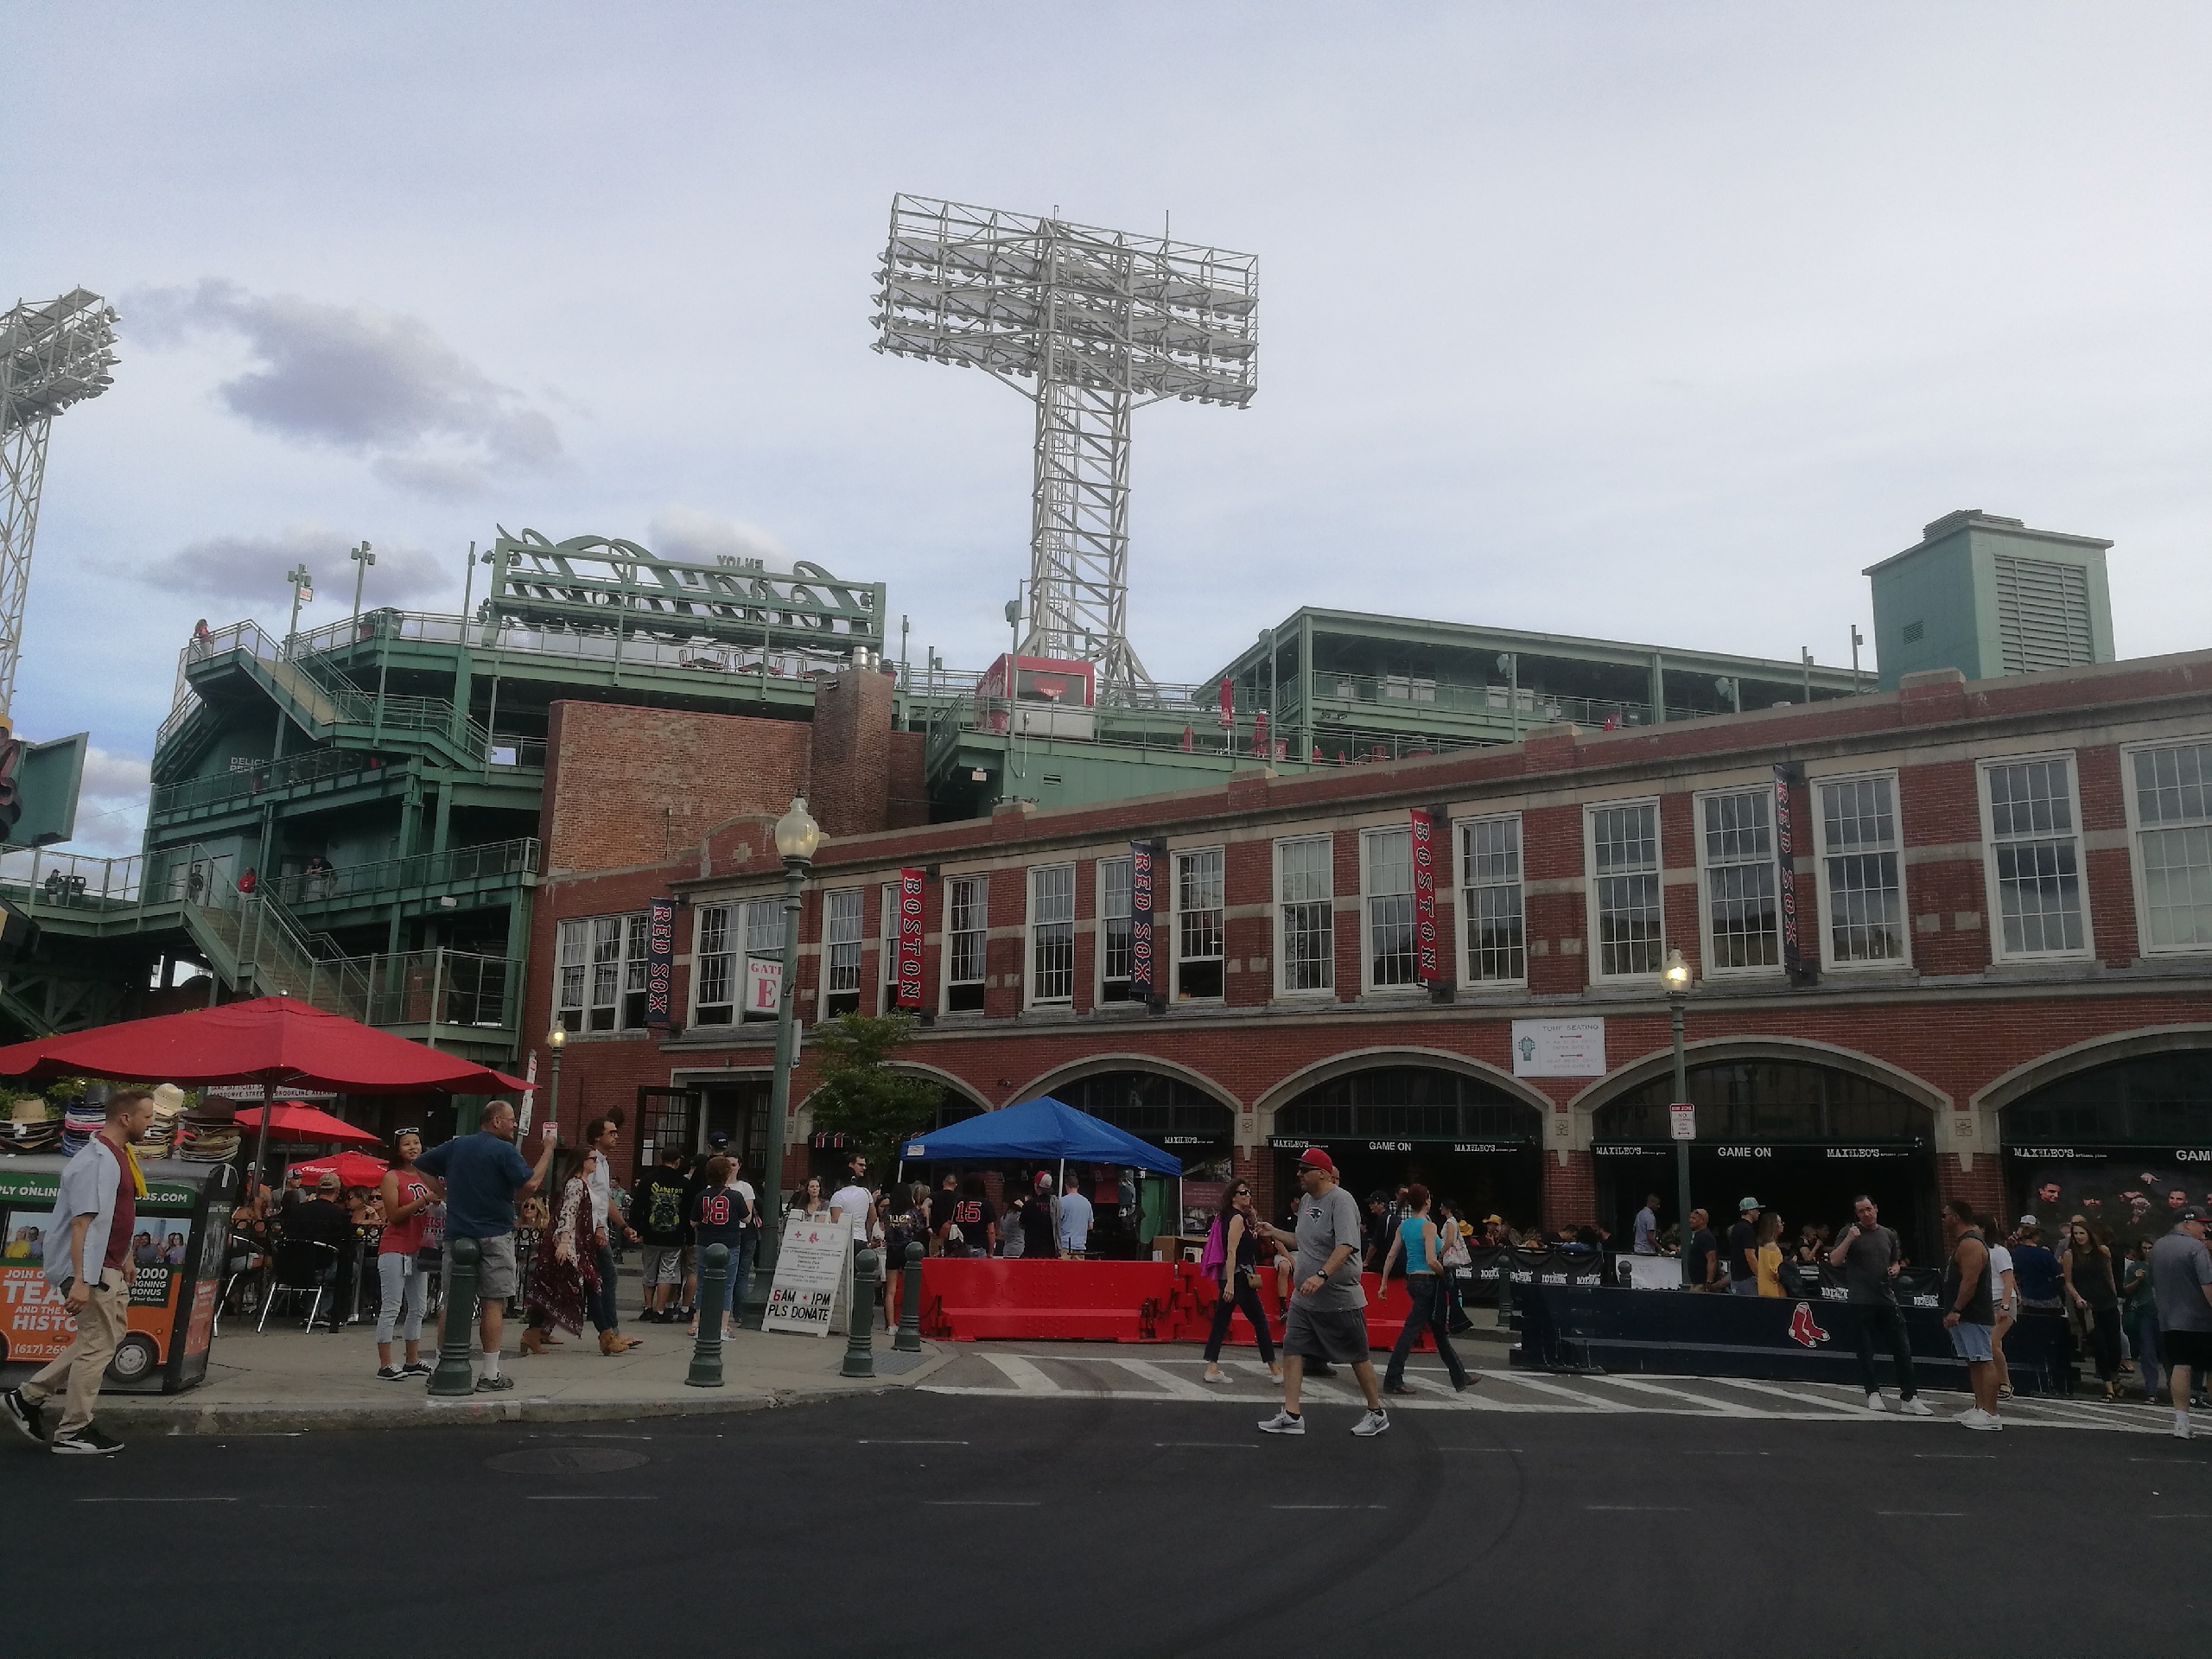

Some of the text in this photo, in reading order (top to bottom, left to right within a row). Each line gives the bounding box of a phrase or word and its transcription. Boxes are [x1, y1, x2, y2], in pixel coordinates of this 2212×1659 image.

[1776, 778, 1796, 947] RED SOX
[1414, 819, 1436, 970] BOSTON
[1134, 851, 1152, 984] RED SOX
[900, 876, 922, 999] BOSTON
[649, 906, 672, 1014] RED SOX
[756, 978, 776, 1008] E
[1369, 1141, 1411, 1151] GAME ON
[1718, 1147, 1772, 1157] GAME ON
[2176, 1150, 2212, 1161] GAM
[702, 1196, 729, 1224] 18
[956, 1201, 982, 1223] 15
[4, 1269, 35, 1279] JOIN
[773, 1290, 796, 1303] 6AM
[768, 1304, 830, 1321] PLS DONATE
[12, 1316, 78, 1332] HISTO
[15, 1344, 44, 1355] (617)
